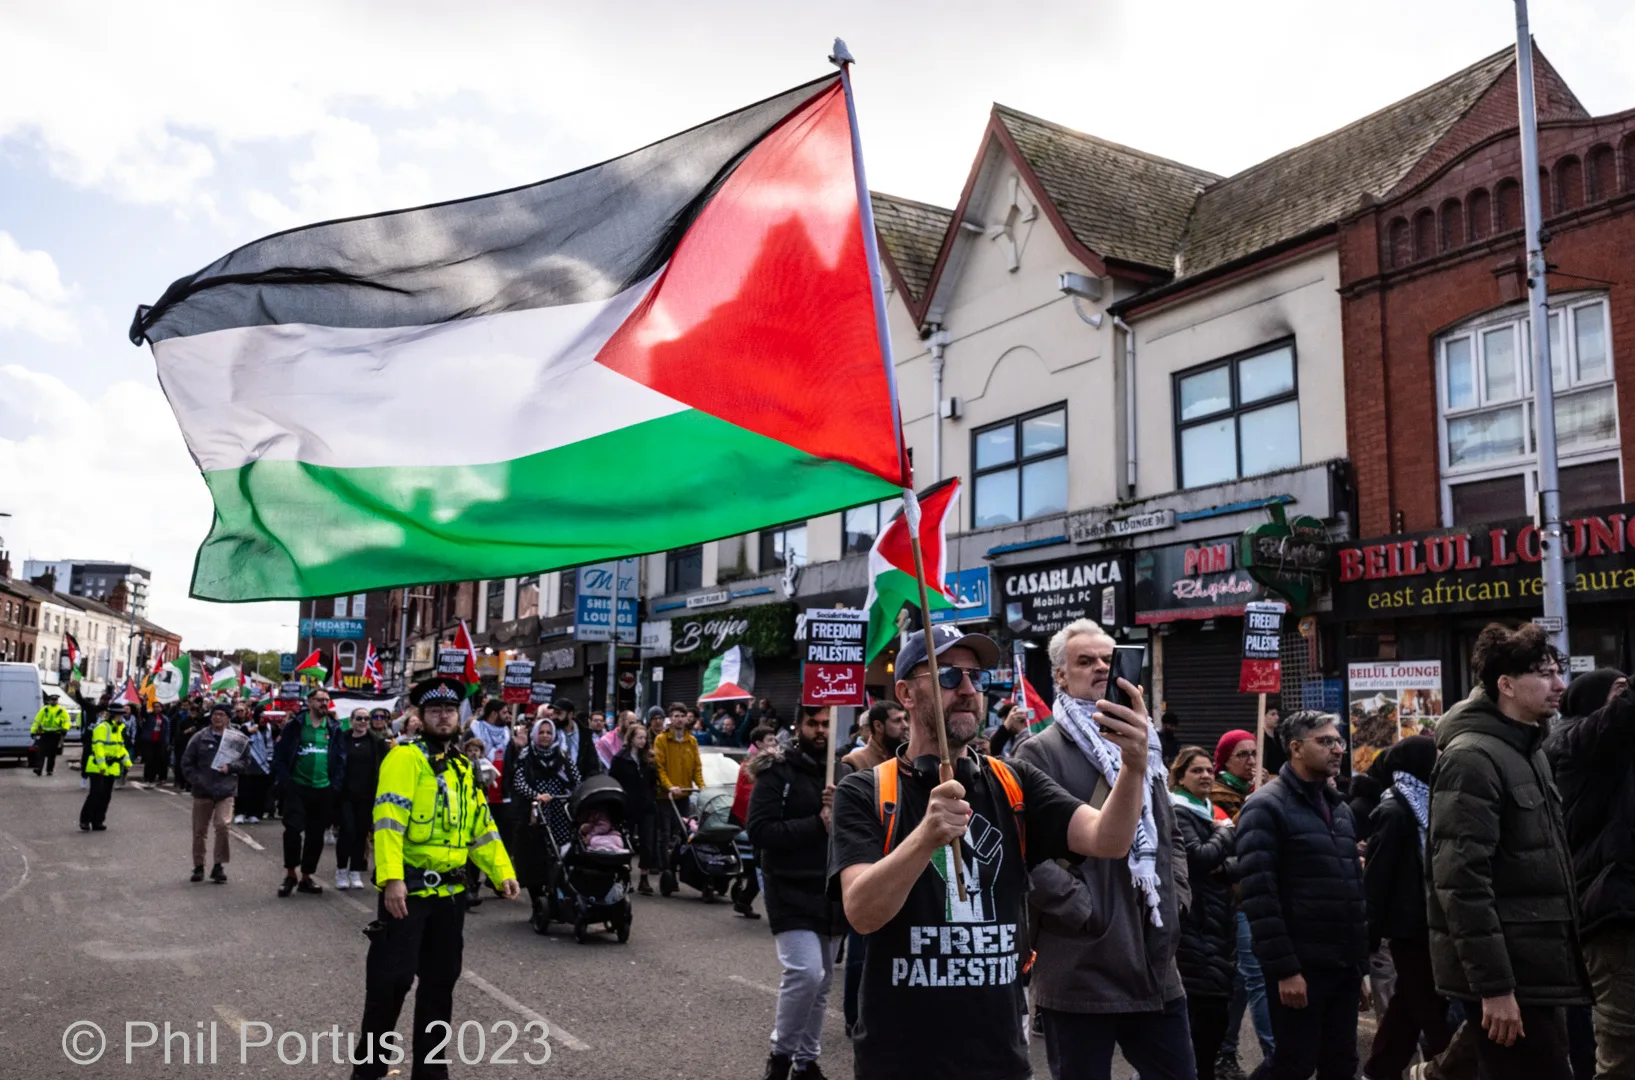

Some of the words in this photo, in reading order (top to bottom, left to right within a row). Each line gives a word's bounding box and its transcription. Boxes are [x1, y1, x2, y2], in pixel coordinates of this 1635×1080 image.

[1119, 517, 1154, 532] LOUNGE
[1339, 533, 1481, 582] BEILUL
[1489, 513, 1635, 568] LOUN
[584, 569, 633, 591] Mst
[1005, 560, 1122, 596] CASABLANCA
[1033, 595, 1065, 608] Mobile
[1068, 593, 1075, 604] &
[1078, 590, 1091, 602] PC
[1367, 589, 1414, 609] east
[1421, 577, 1511, 606] african
[314, 621, 363, 630] MEDASTRA
[583, 612, 632, 624] LOUGE
[673, 615, 750, 653] Boujee
[811, 622, 862, 639] FREEDOM
[807, 645, 864, 662] PALESTINE
[1350, 667, 1388, 679] BEILUL
[1390, 666, 1440, 678] LOUNGE
[910, 923, 1017, 955] FREE
